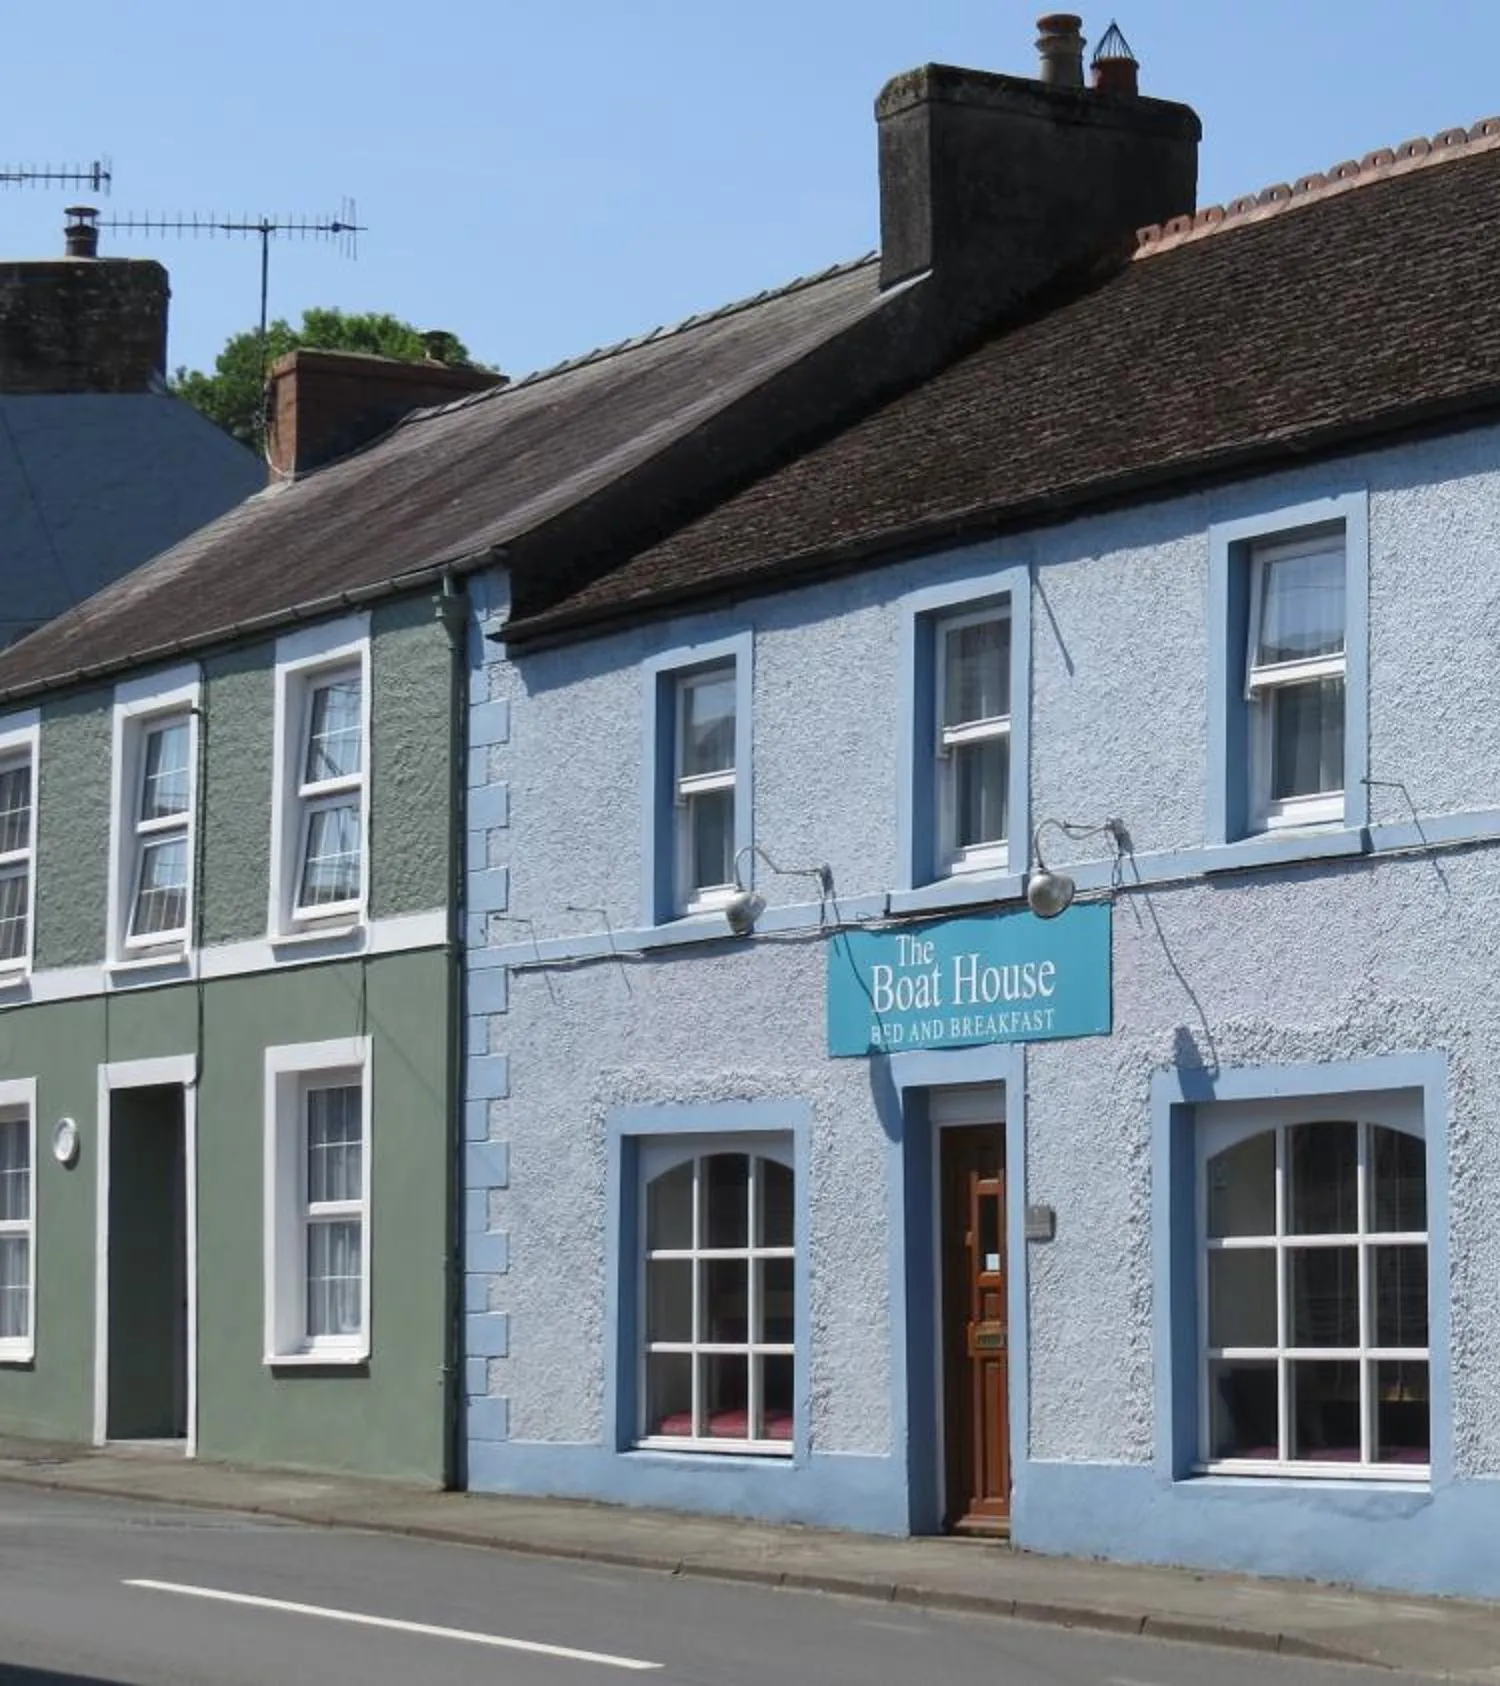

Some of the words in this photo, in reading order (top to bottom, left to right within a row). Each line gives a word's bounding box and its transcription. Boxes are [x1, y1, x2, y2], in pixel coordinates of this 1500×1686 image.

[896, 934, 934, 966] The
[871, 965, 942, 1013] Boat
[952, 953, 1055, 1004] House
[871, 1021, 903, 1044] BED
[909, 1018, 944, 1042] AND
[951, 1009, 1055, 1037] BREAKFAST
